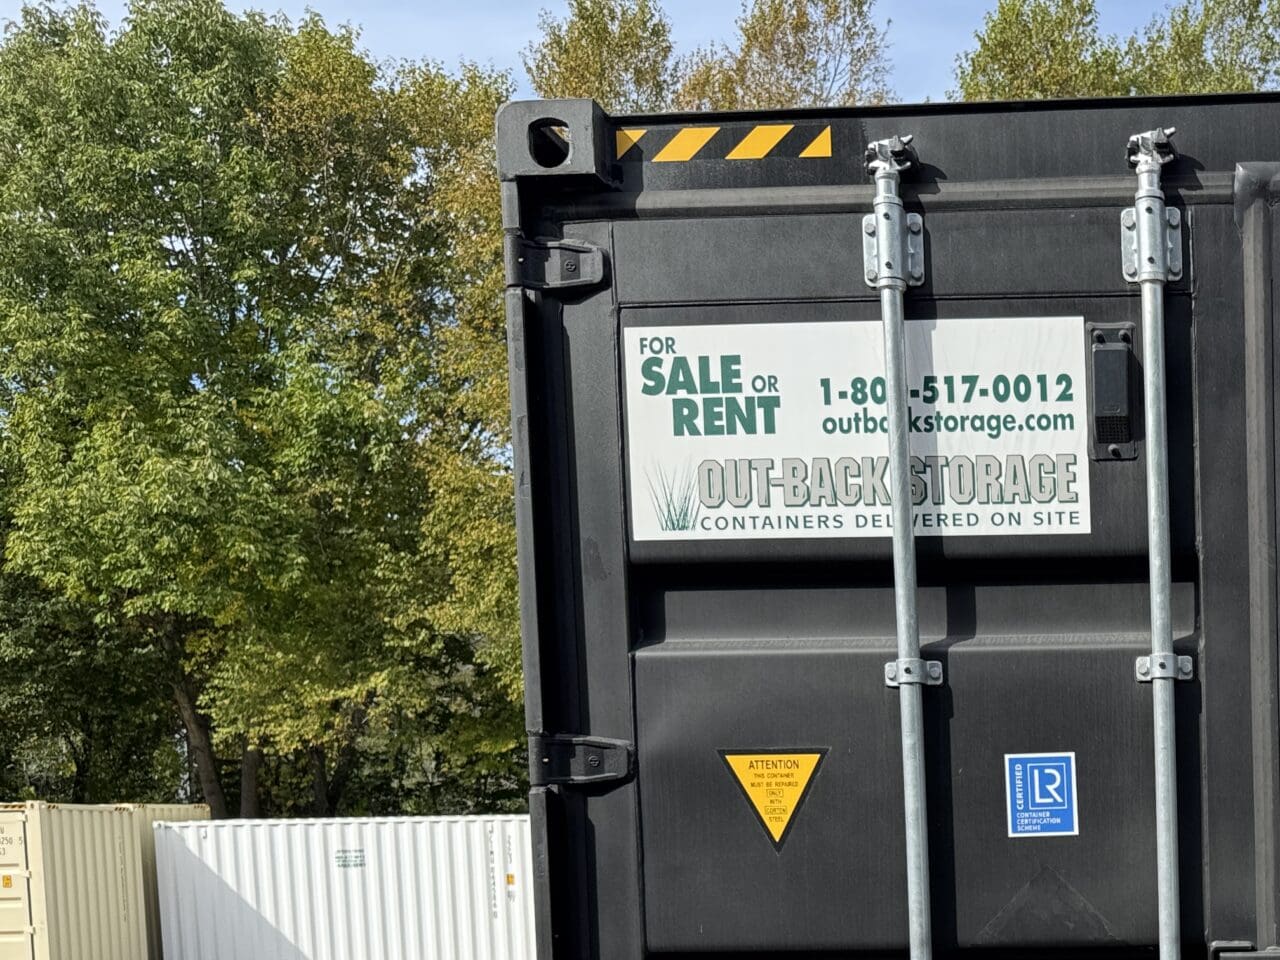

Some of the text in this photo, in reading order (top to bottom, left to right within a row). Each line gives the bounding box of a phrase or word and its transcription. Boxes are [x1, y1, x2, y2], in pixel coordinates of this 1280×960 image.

[639, 336, 677, 355] FOR
[641, 354, 779, 396] SALE OR
[820, 374, 1074, 406] 1-80-517-0012
[672, 395, 781, 436] RENT
[822, 406, 1075, 439] outbakstorage.com
[698, 453, 1080, 508] OUT-BACK STORAGE
[700, 513, 845, 531] CONTAINERS
[990, 511, 1022, 527] ON
[1033, 509, 1081, 526] SITE
[748, 760, 800, 770] ATTENTION
[1014, 763, 1025, 810] CERTIFIED
[1033, 768, 1064, 804] LR
[1016, 817, 1062, 825] CERTIFICATION
